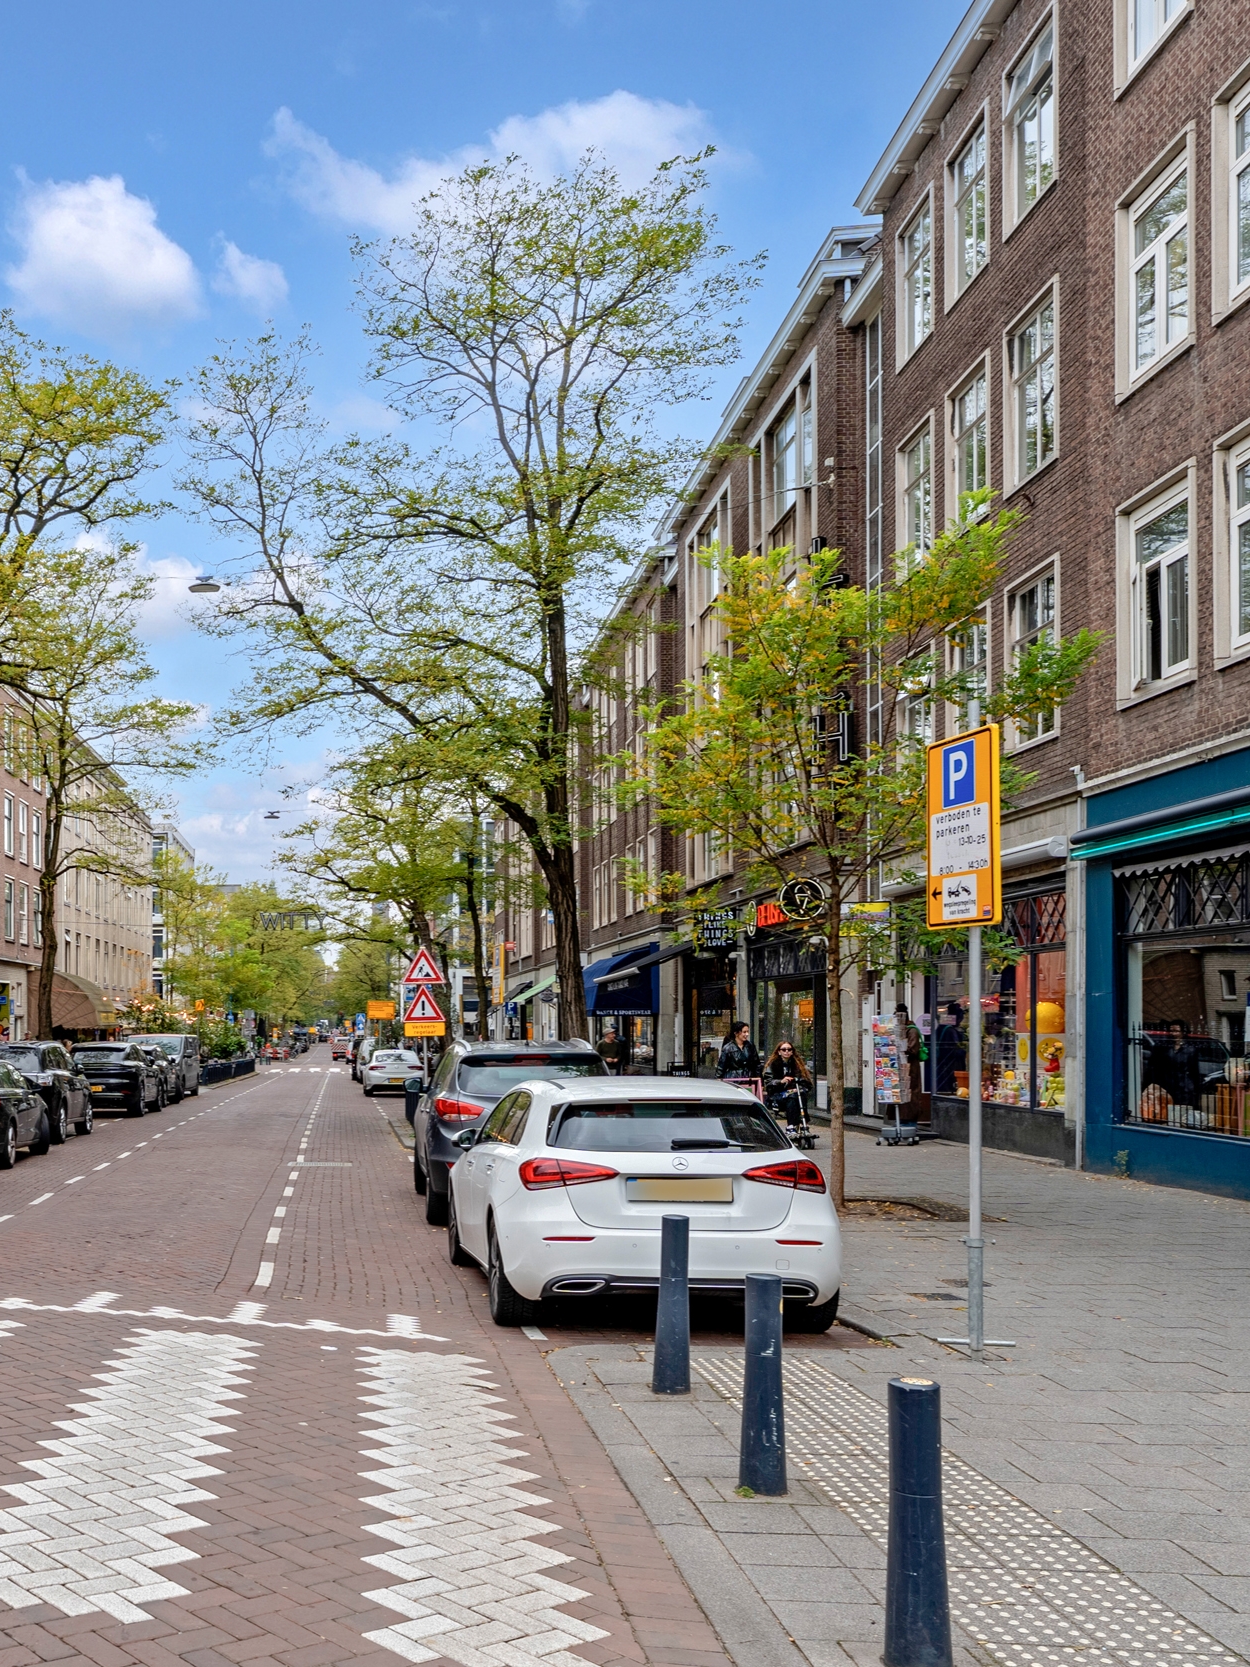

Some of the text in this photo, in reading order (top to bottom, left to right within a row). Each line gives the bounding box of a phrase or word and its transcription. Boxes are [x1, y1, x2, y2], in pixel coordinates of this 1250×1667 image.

[949, 750, 968, 800] P
[935, 807, 982, 825] verboden te
[935, 824, 970, 840] parkeren
[959, 834, 987, 846] 13-10-25
[939, 864, 955, 876] 8:00
[968, 858, 989, 871] 14:30h
[259, 912, 328, 930] WITTY
[698, 930, 734, 938] THINGS
[708, 939, 727, 947] LOVE
[508, 1002, 515, 1010] P
